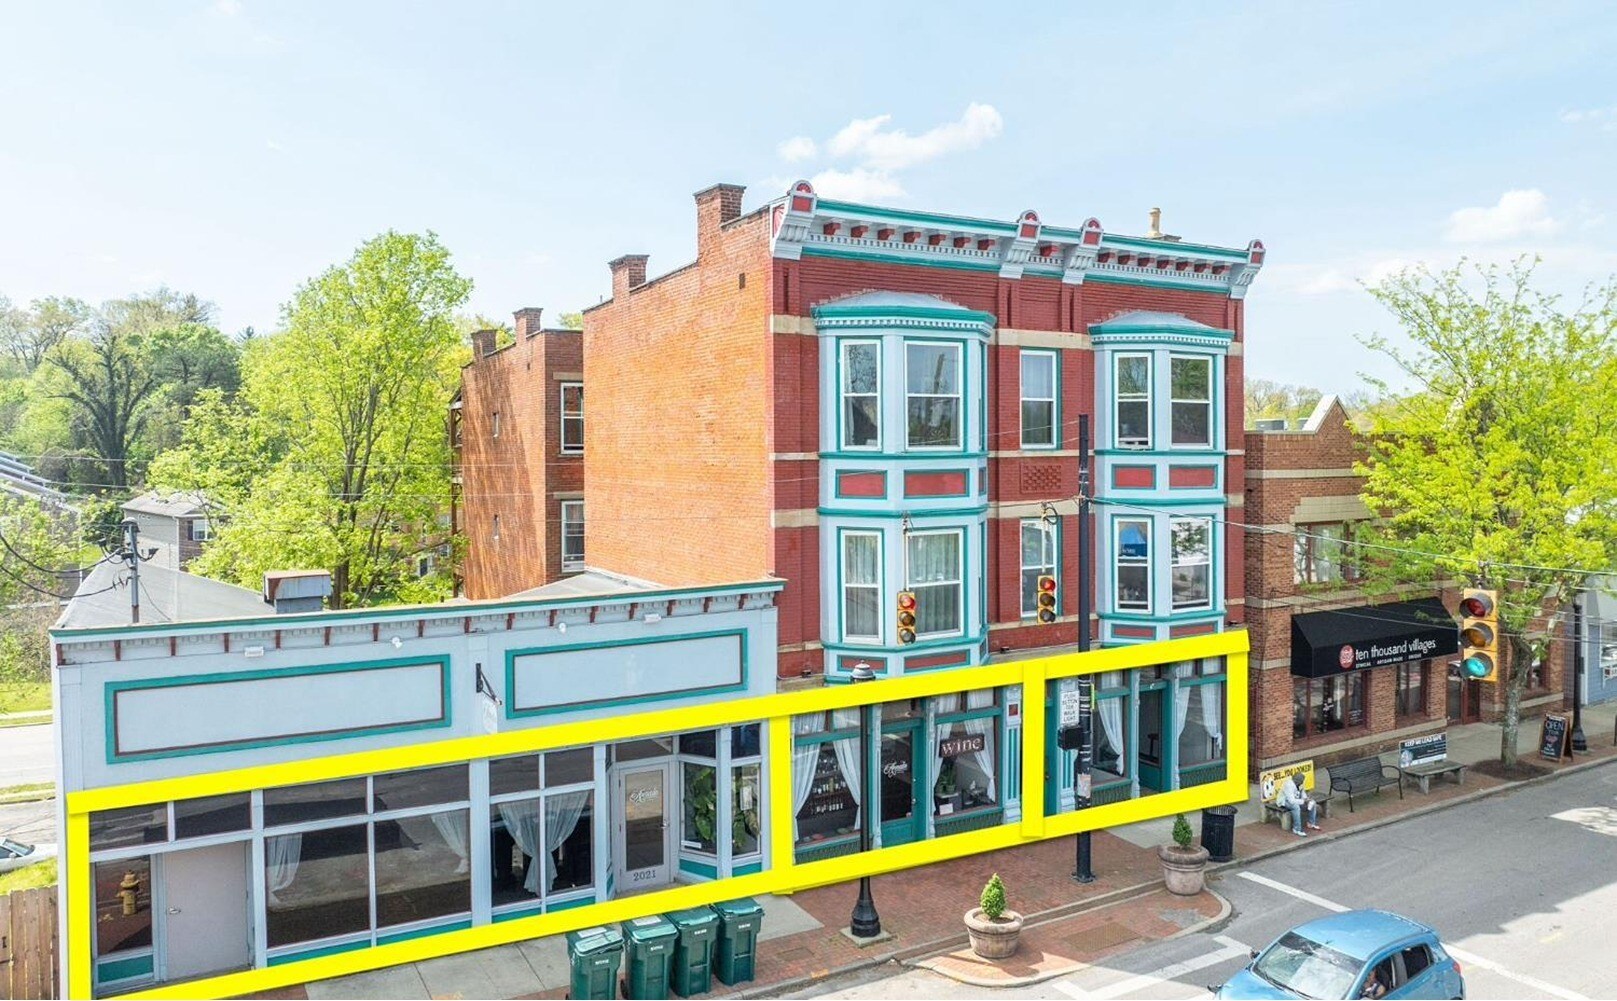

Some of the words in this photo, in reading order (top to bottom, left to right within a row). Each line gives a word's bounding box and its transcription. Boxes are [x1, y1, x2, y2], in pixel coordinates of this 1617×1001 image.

[1355, 649, 1369, 661] ten
[1371, 640, 1407, 658] thousand
[1409, 638, 1436, 654] villages
[1545, 720, 1563, 730] OPEN
[941, 737, 981, 755] wine
[633, 869, 657, 882] 2021
